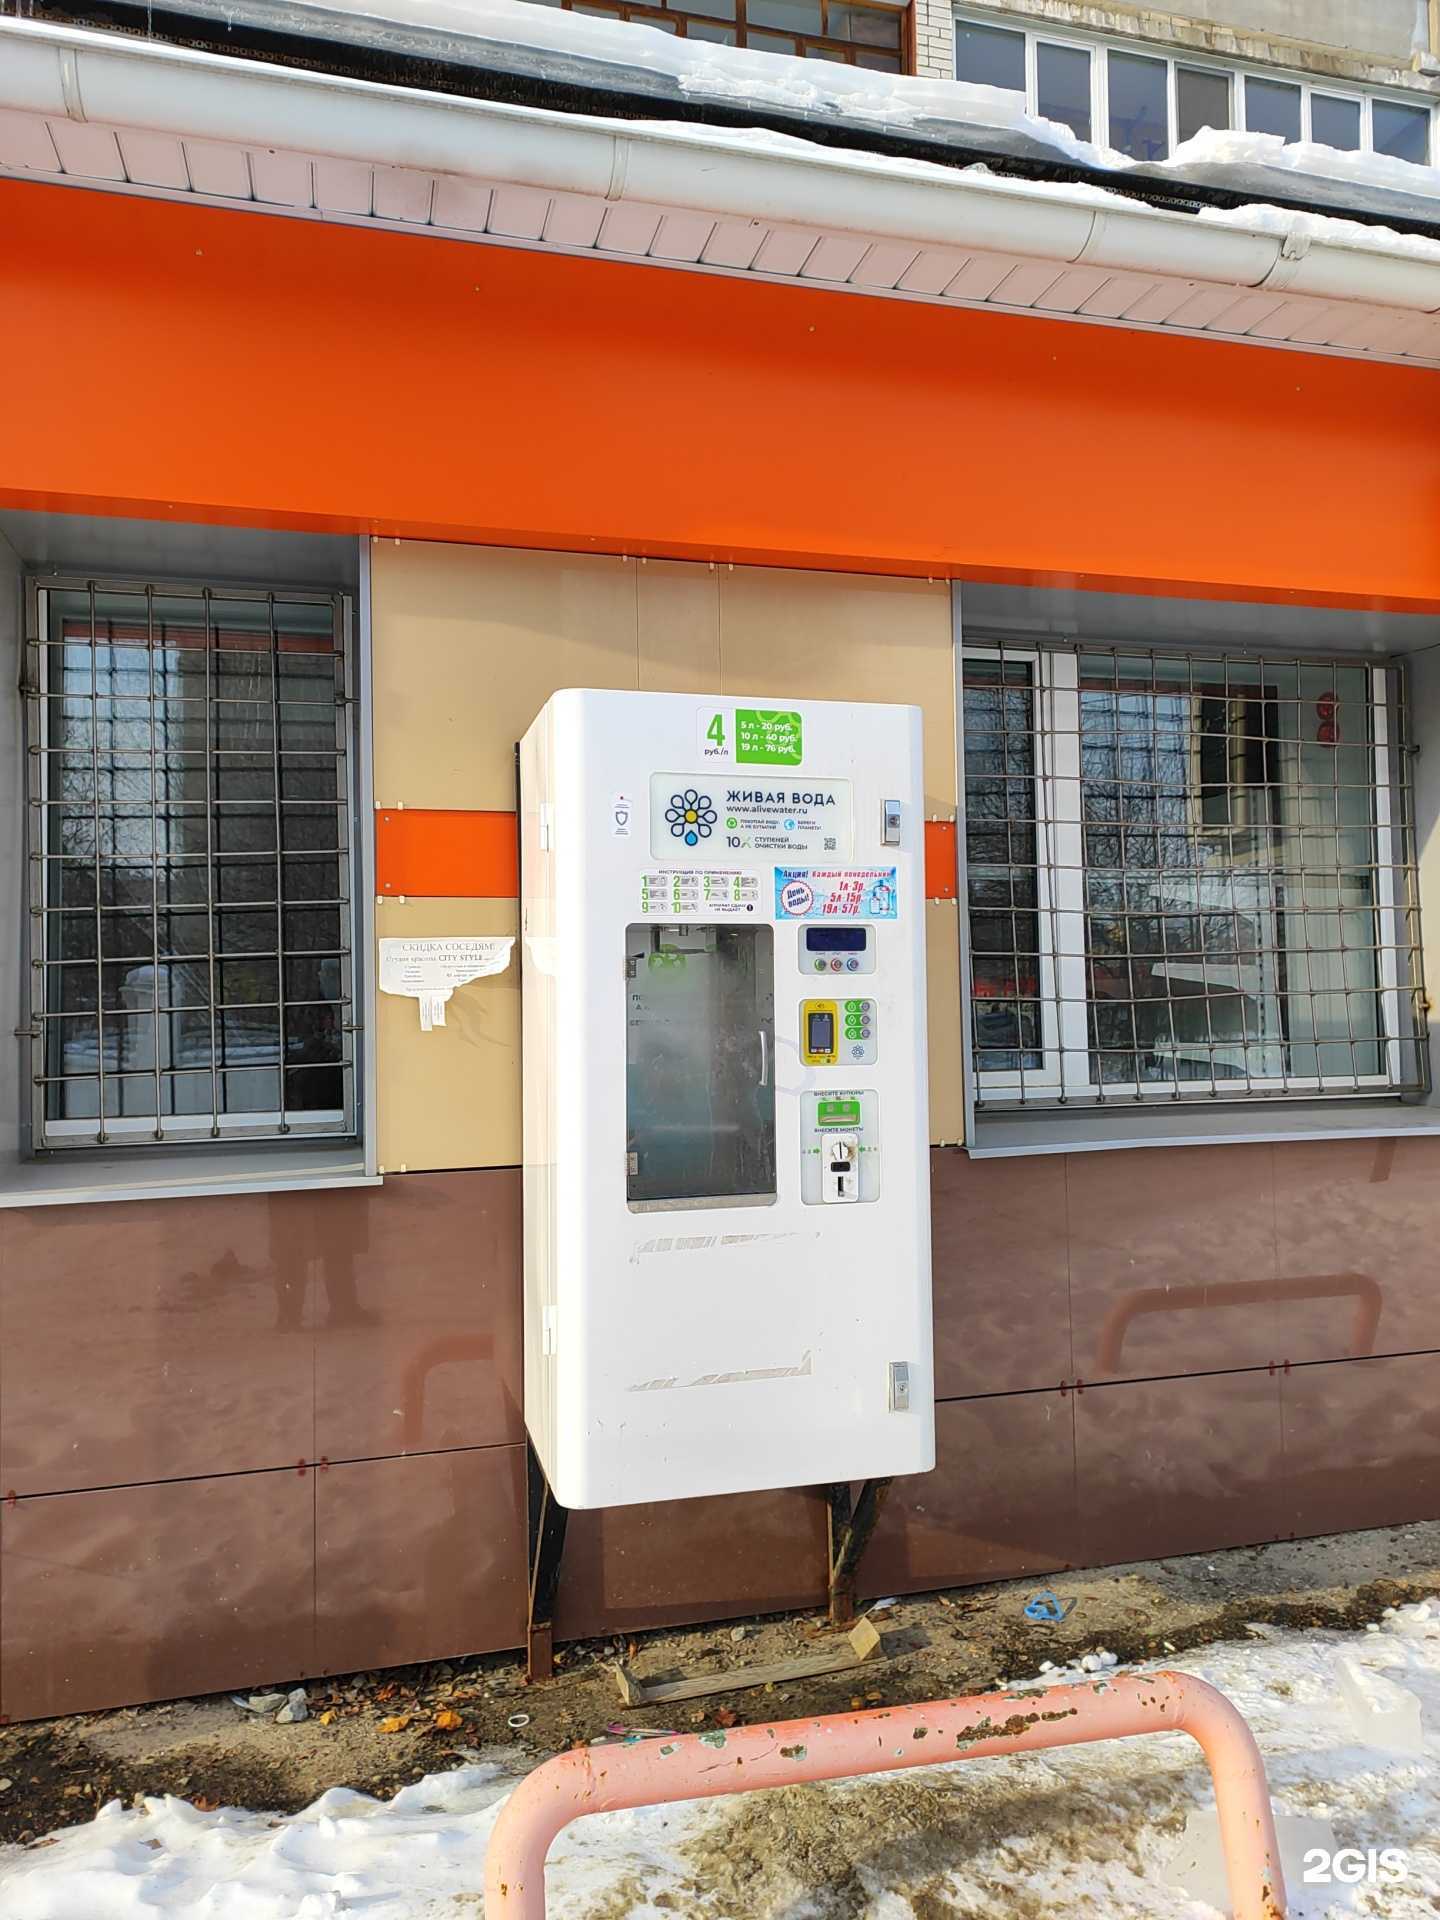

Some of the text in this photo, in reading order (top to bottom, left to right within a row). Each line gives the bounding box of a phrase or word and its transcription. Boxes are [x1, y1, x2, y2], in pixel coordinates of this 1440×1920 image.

[706, 714, 726, 747] 4
[741, 721, 747, 729] 5
[761, 722, 773, 730] 20
[775, 722, 793, 732] руб.
[741, 732, 751, 740] 10
[766, 733, 778, 741] 40
[779, 734, 797, 743] руб.
[704, 748, 729, 757] руб./л
[778, 745, 796, 754] руб.
[726, 790, 836, 807] ЖИВАЯ ВОДА
[726, 804, 808, 815] www.alivewater.ru
[726, 836, 740, 848] 10
[783, 870, 809, 879] Акция!
[641, 875, 647, 887] 1
[673, 875, 681, 888] 2
[704, 876, 711, 888] 3
[733, 876, 740, 888] 4
[642, 888, 649, 900] 5
[673, 888, 680, 901] 6
[704, 889, 711, 901] 7
[733, 889, 740, 901] 8
[642, 901, 649, 914] 9
[671, 901, 681, 914] 10
[402, 943, 443, 952] СКИДКА
